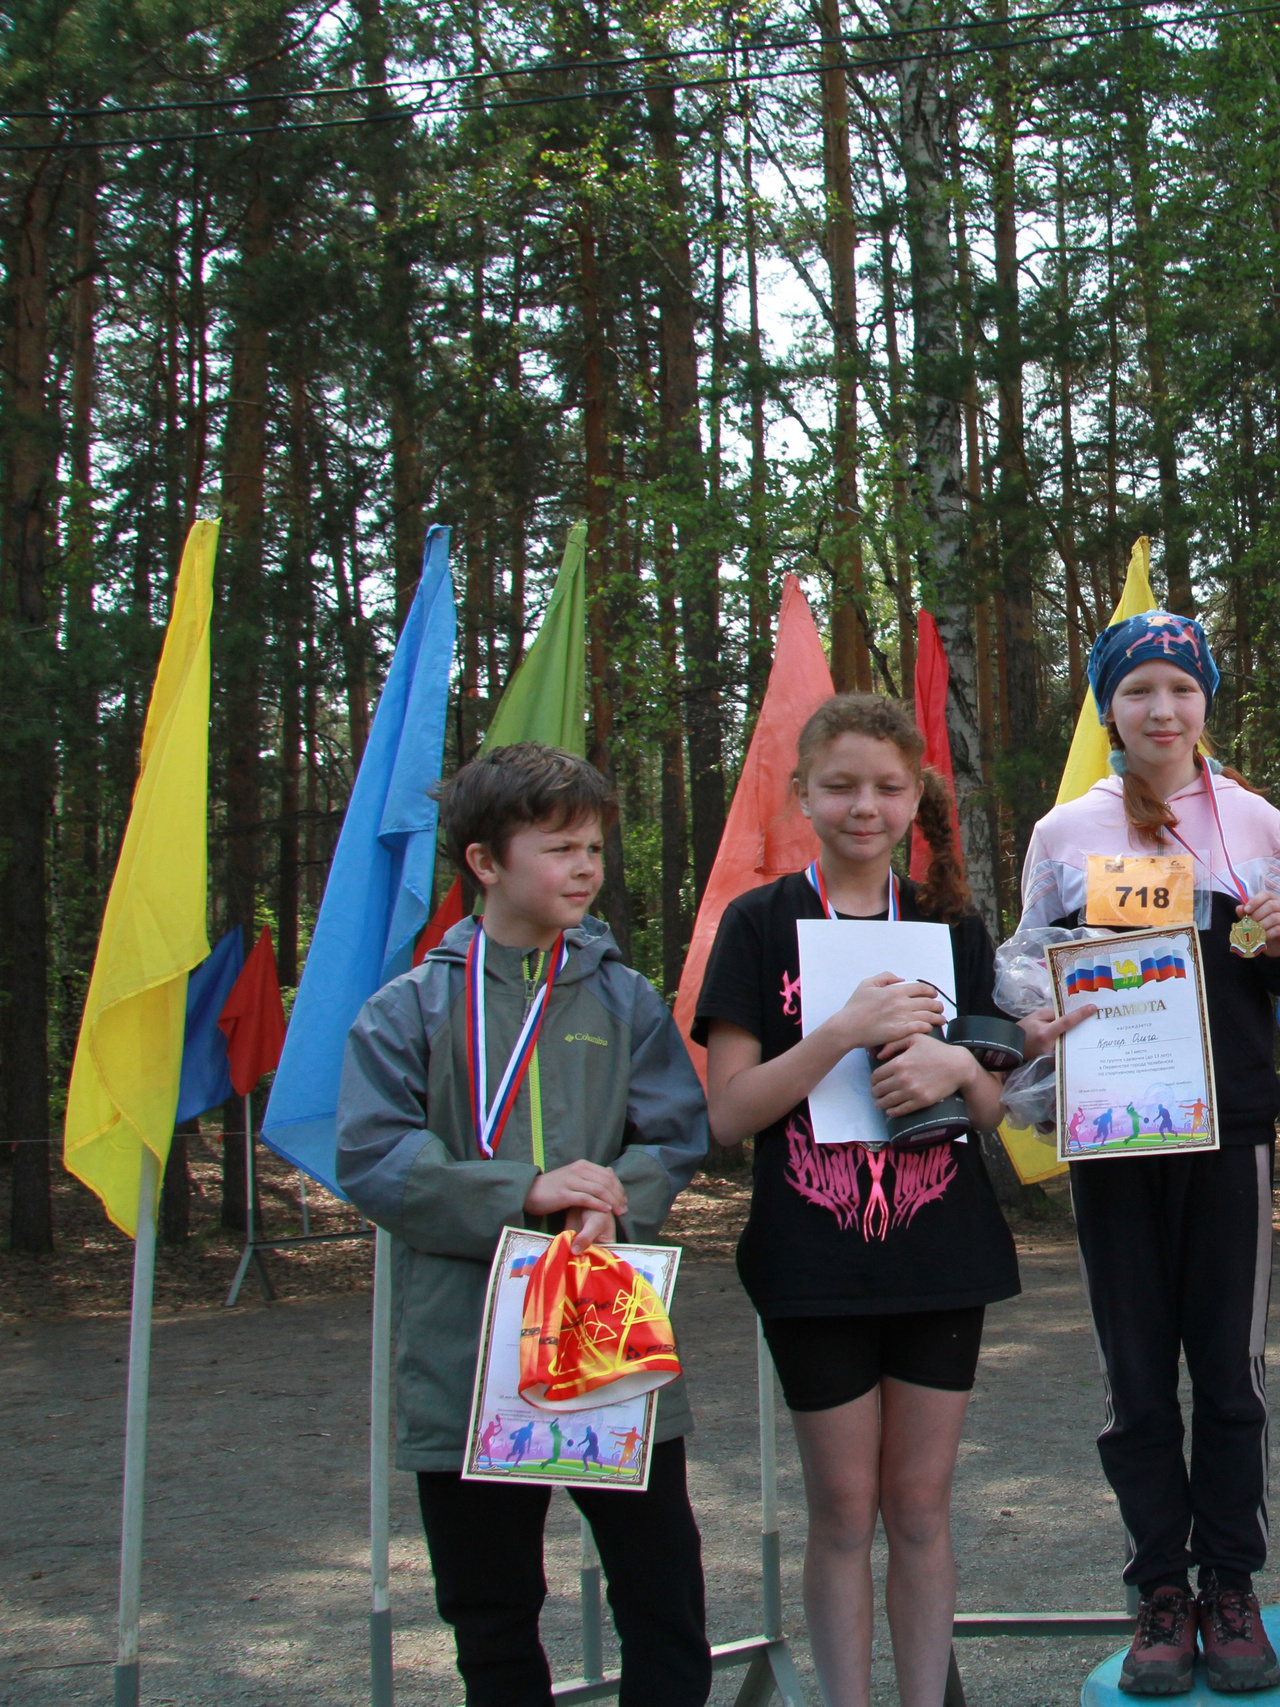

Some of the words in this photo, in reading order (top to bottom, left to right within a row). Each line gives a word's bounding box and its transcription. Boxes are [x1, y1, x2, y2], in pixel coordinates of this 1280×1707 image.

[1116, 887, 1170, 909] 718
[1244, 932, 1250, 942] 1
[1095, 1000, 1167, 1020] ГРАМОТА
[574, 1032, 608, 1047] Columbia
[1132, 1033, 1158, 1043] Ольга
